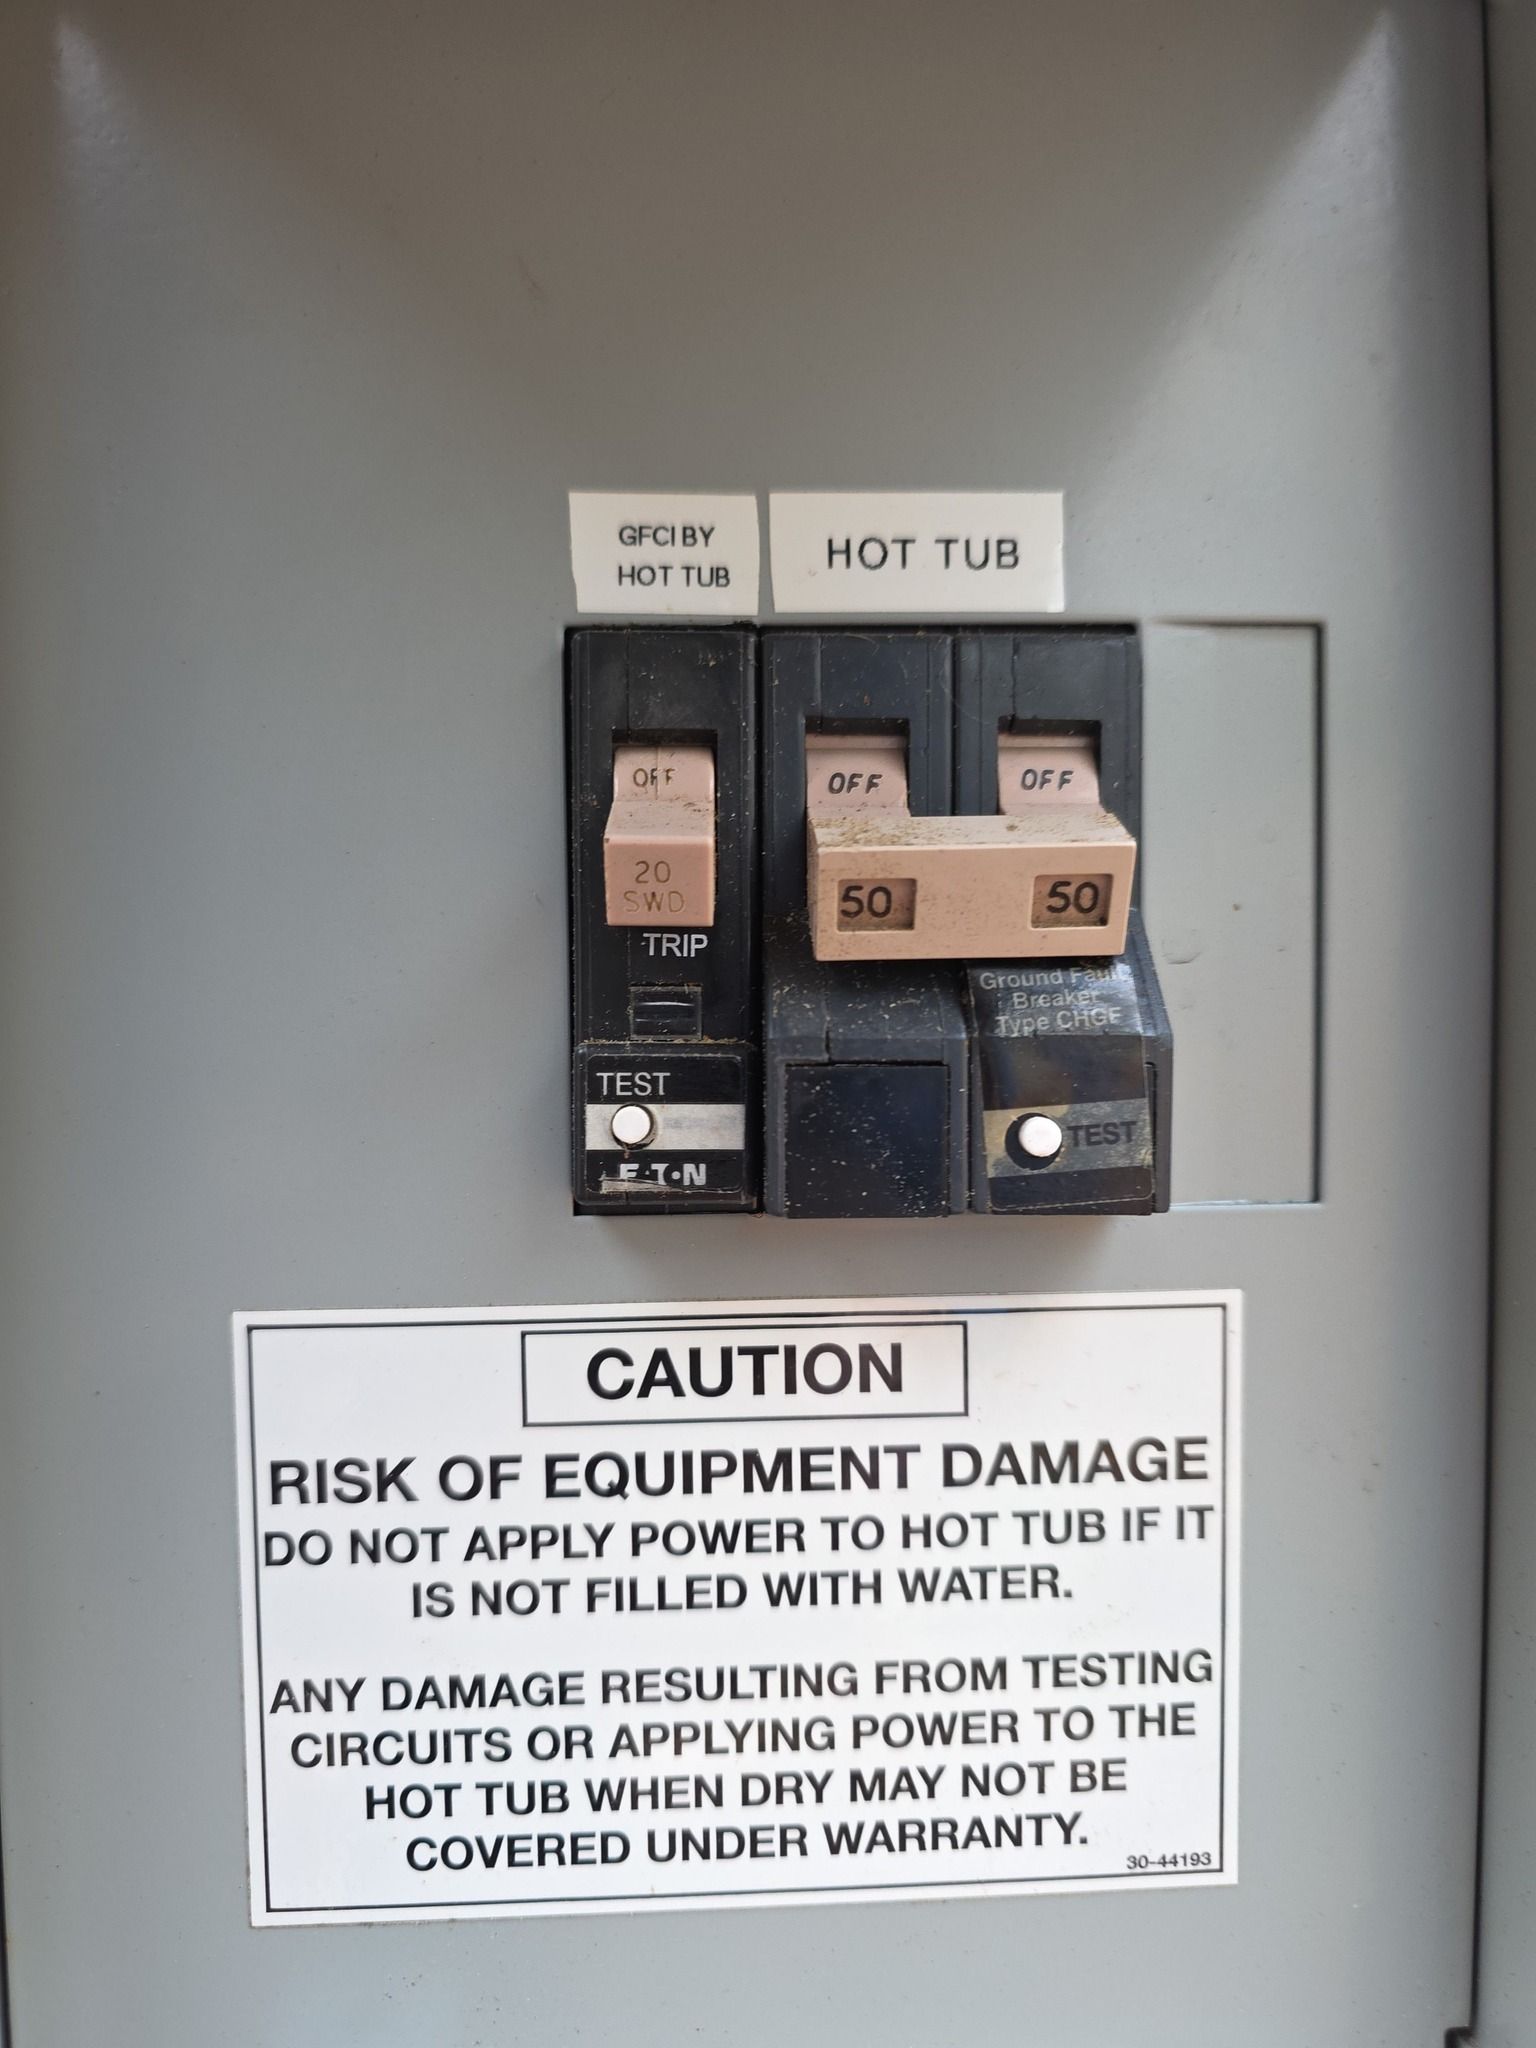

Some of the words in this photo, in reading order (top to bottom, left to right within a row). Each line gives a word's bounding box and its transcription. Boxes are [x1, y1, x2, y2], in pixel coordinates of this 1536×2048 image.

[618, 525, 676, 547] GFCI
[681, 526, 715, 547] BY
[827, 538, 916, 570] HOT
[934, 538, 1020, 570] TUB
[618, 565, 673, 587] HOT
[682, 566, 730, 588] TUB
[633, 768, 675, 787] OFF
[828, 772, 882, 794] OFF
[1021, 769, 1074, 790] OFF
[635, 861, 671, 883] 20
[624, 891, 684, 912] SWD
[840, 885, 892, 918] 50
[1046, 881, 1099, 914] 50
[643, 933, 708, 957] TRIP
[980, 969, 1063, 989] Ground
[1012, 990, 1099, 1009] Breaker
[995, 1016, 1049, 1037] Type
[596, 1072, 671, 1095] TEST
[1066, 1121, 1137, 1147] TEST
[586, 1341, 903, 1401] CAUTION
[270, 1456, 417, 1505] RISK
[438, 1454, 522, 1502] OF
[544, 1445, 921, 1500] EQUIPMENT
[942, 1437, 1208, 1488] DAMAGE
[264, 1529, 332, 1567] DO
[350, 1527, 449, 1565] NOT
[463, 1523, 614, 1562] APPLY
[631, 1518, 806, 1557] POWER
[820, 1516, 885, 1551] TO
[902, 1512, 998, 1549] HOT
[1013, 1510, 1106, 1545] TUB
[1124, 1507, 1160, 1542] IF
[1178, 1506, 1214, 1540] IT
[412, 1582, 454, 1618] IS
[471, 1579, 570, 1616] NOT
[586, 1575, 748, 1613] FILLED
[763, 1570, 882, 1607] WITH
[898, 1565, 1073, 1603] WATER.
[269, 1677, 366, 1714] ANY
[382, 1671, 585, 1711] DAMAGE
[601, 1663, 858, 1704] RESULTING
[875, 1658, 1007, 1695] FROM
[1023, 1649, 1212, 1689] TESTING
[291, 1727, 512, 1769] CIRCUITS
[527, 1725, 594, 1761] OR
[608, 1717, 835, 1758] APPLYING
[852, 1711, 1019, 1749] POWER
[1034, 1707, 1094, 1742] TO
[1109, 1702, 1196, 1738] THE
[365, 1783, 462, 1820] HOT
[475, 1780, 570, 1816] TUB
[584, 1775, 723, 1812] WHEN
[741, 1770, 833, 1807] DRY
[849, 1766, 944, 1802] MAY
[962, 1762, 1054, 1798] NOT
[1070, 1758, 1126, 1793] BE
[406, 1831, 631, 1872] COVERED
[647, 1824, 808, 1863] UNDER
[823, 1812, 1088, 1855] WARRANTY.
[1127, 1851, 1211, 1869] 30-44193
